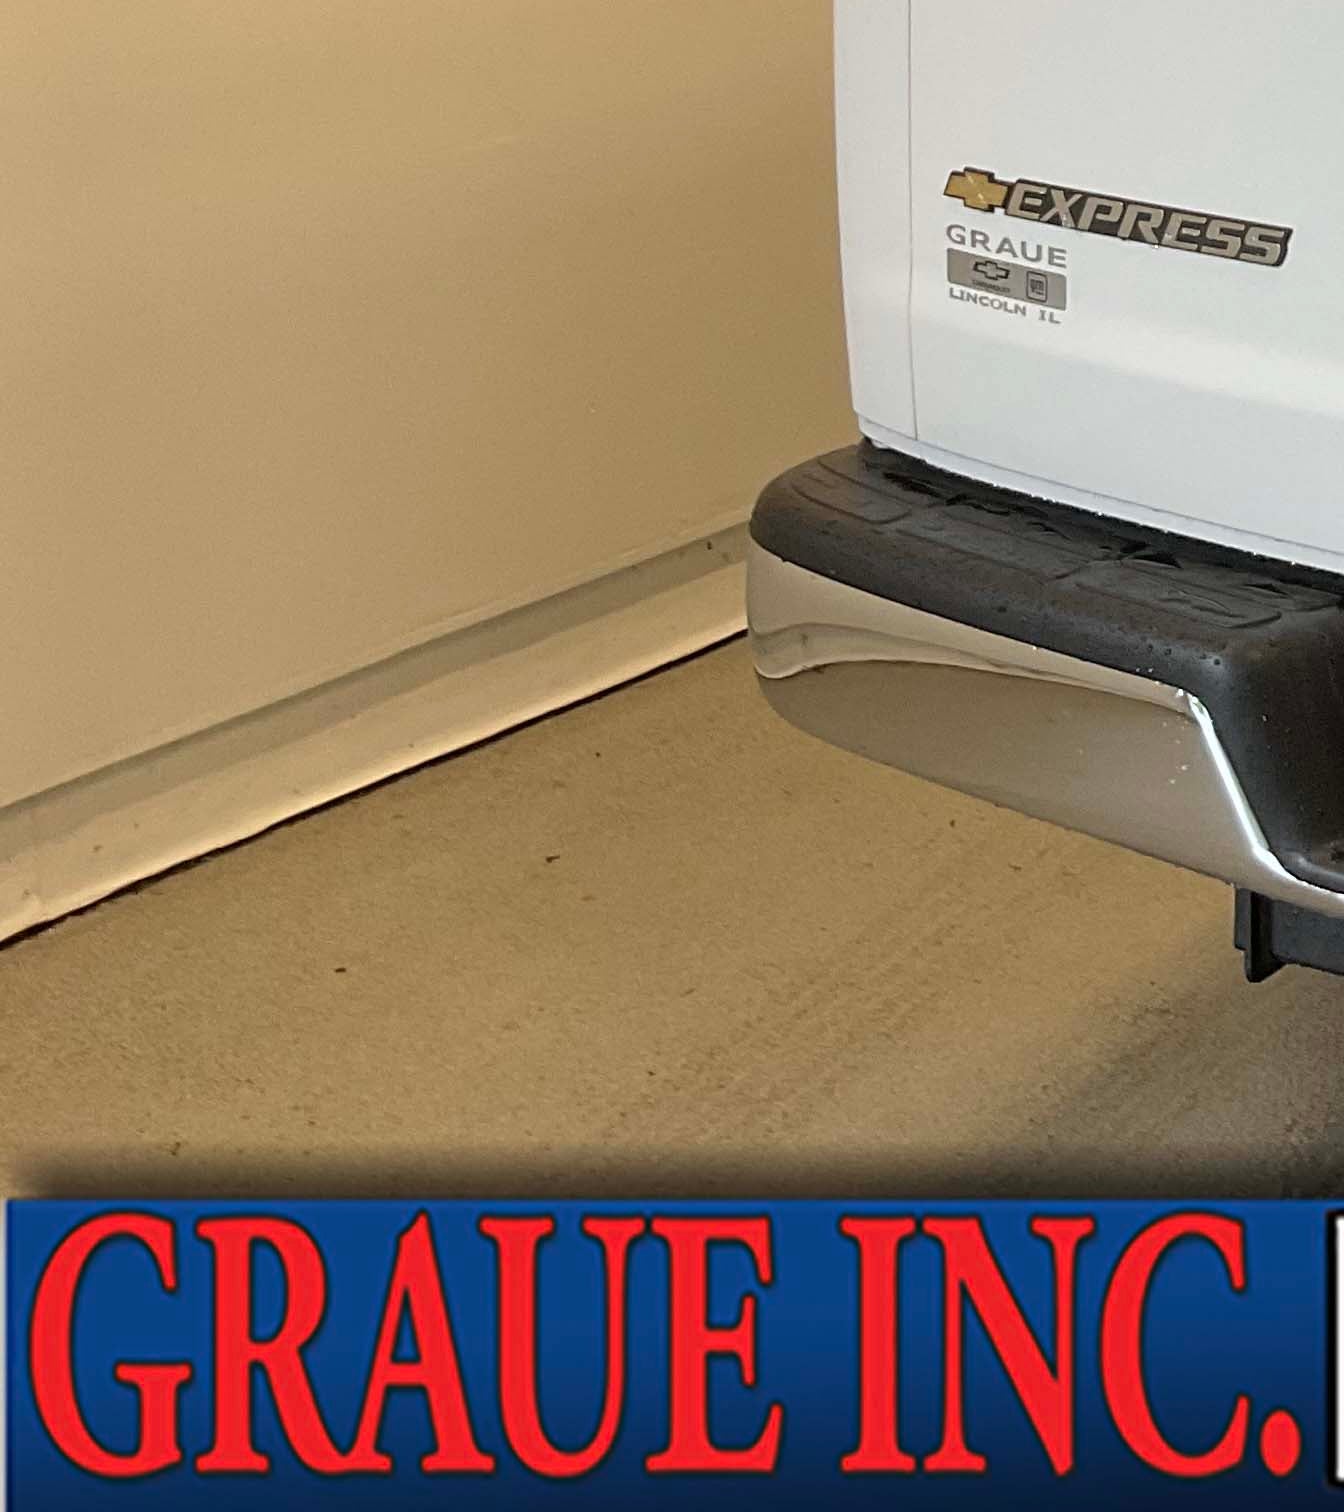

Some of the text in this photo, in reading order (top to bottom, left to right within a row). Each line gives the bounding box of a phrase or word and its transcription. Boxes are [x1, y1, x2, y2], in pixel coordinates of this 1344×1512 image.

[945, 223, 1068, 269] GRAUE
[1006, 181, 1286, 265] EXPRESS
[948, 287, 1027, 317] LINCOLN
[1038, 308, 1063, 325] IL
